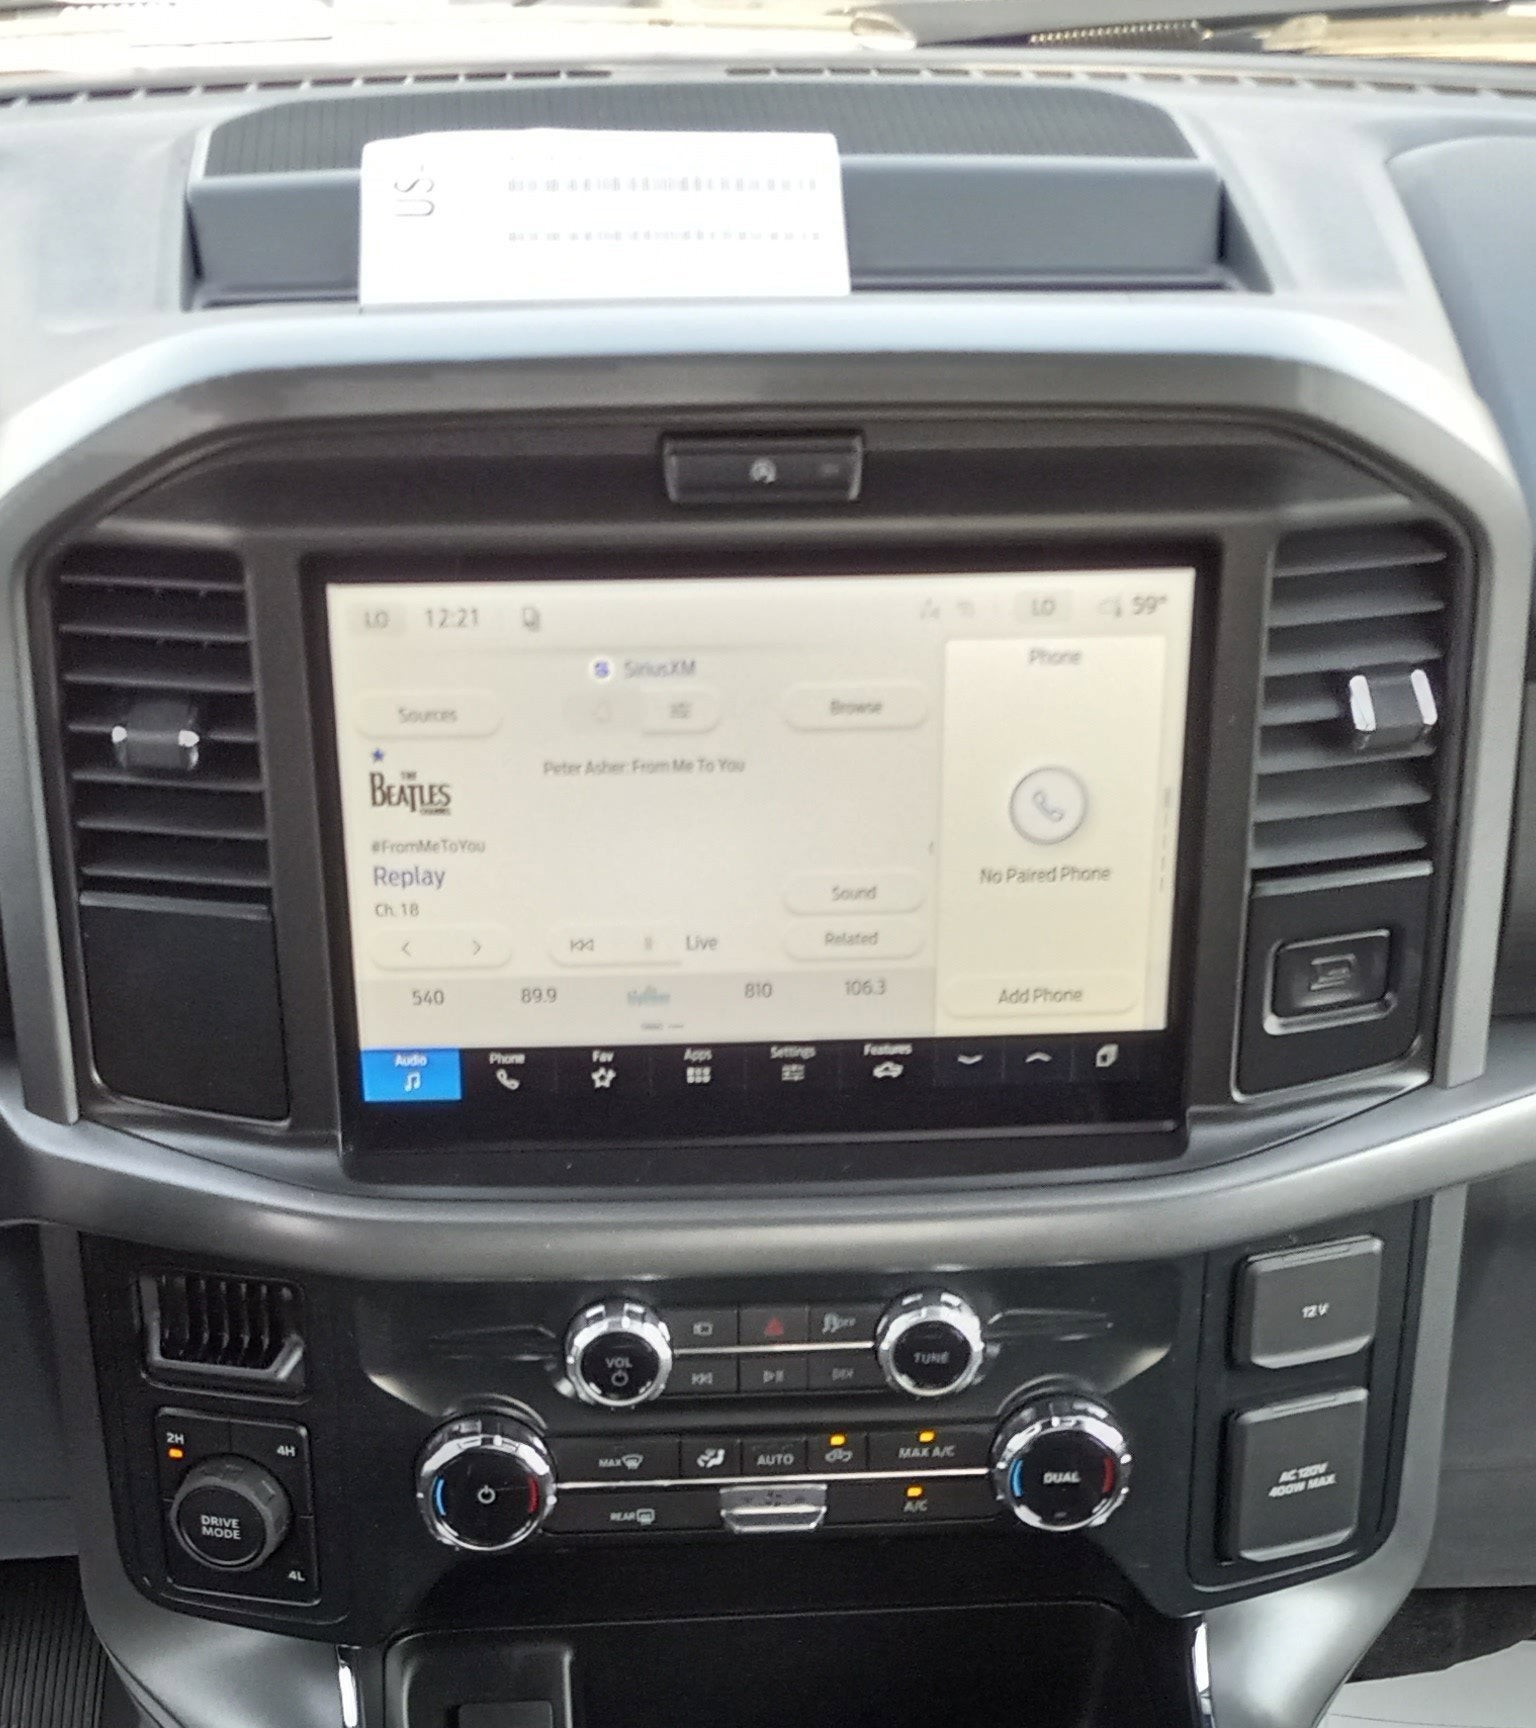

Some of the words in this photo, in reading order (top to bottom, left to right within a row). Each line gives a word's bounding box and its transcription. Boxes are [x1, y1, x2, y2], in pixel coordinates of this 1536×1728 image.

[425, 607, 480, 629] 12:21
[1027, 646, 1083, 667] Phone
[623, 659, 696, 679] SiriusXM
[397, 706, 459, 724] Sources
[829, 698, 883, 716] Browse
[370, 839, 487, 855] #FromMeToYou
[372, 865, 447, 889] Replay
[978, 868, 1003, 884] No
[1006, 866, 1057, 884] Paired
[1059, 865, 1112, 883] Phone
[831, 884, 878, 901] Sound
[400, 902, 420, 917] 18
[684, 935, 719, 952] Live
[824, 930, 879, 947] Related
[411, 990, 445, 1007] 540
[520, 987, 558, 1005] 89.9
[743, 982, 774, 999] 810
[844, 979, 888, 997] 106.3
[997, 988, 1031, 1005] Add
[1032, 986, 1084, 1004] Phone
[394, 1052, 428, 1067] Audio
[488, 1052, 526, 1066] Phone
[591, 1050, 615, 1064] Fav
[683, 1047, 713, 1064] Apps
[769, 1044, 817, 1061] Settings
[604, 1356, 633, 1370] VOL
[914, 1351, 950, 1365] TUNE
[166, 1432, 185, 1445] 2H
[276, 1444, 296, 1458] 4H
[898, 1446, 931, 1460] MAX
[931, 1444, 955, 1459] A/C
[756, 1453, 794, 1467] AUTO
[1042, 1470, 1082, 1485] DUAL
[903, 1499, 928, 1513] A/C
[200, 1514, 240, 1529] DRIVE
[201, 1526, 242, 1540] MODE
[287, 1569, 306, 1583] 4L
